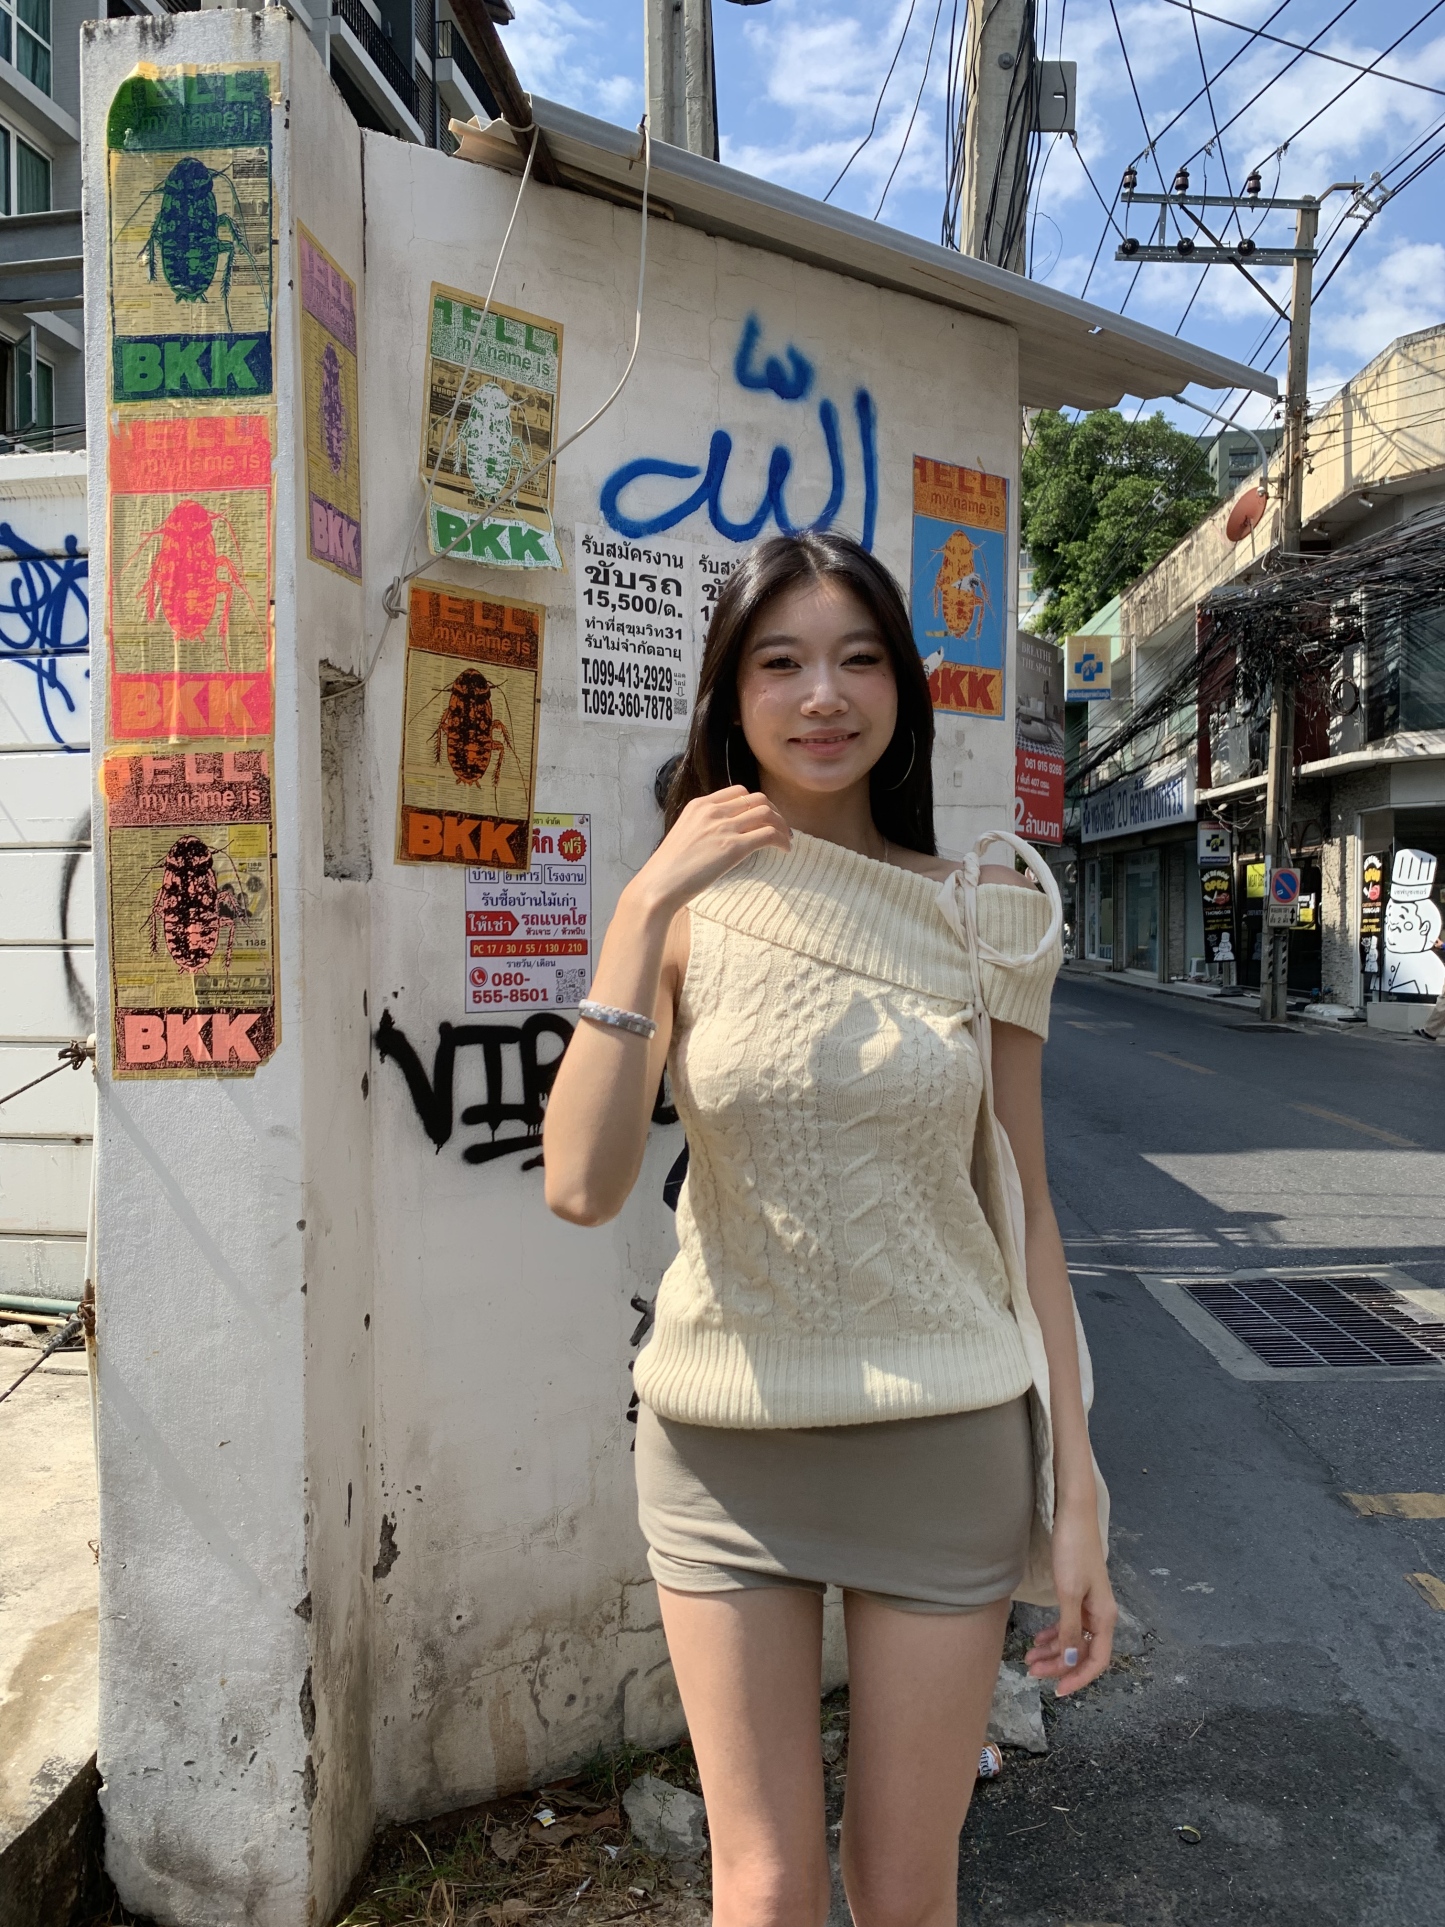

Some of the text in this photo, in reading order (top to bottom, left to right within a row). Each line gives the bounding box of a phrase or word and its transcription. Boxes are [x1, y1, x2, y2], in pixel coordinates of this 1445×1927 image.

[141, 106, 261, 134] my name is
[121, 339, 259, 393] BKK
[488, 346, 531, 369] name
[537, 358, 550, 375] is
[180, 454, 235, 472] name
[242, 453, 261, 472] is
[931, 492, 1000, 517] my name is
[313, 500, 357, 570] BKK
[436, 511, 550, 562] BKK
[582, 534, 683, 569] รับสมัครงาน
[584, 560, 682, 597] ขับรถ
[583, 588, 683, 618] 15,500/ด.
[435, 627, 530, 655] my name is
[585, 615, 682, 640] ทำที่สุขุมวิท31
[585, 633, 681, 662] รับไม่จำกัดอายุ
[1021, 641, 1052, 663] BREATHE
[582, 657, 672, 692] T.099-413-2929
[1021, 656, 1035, 670] THE
[119, 680, 256, 730] BKK
[582, 688, 672, 721] T.092-360-7878
[139, 786, 261, 813] my name is
[1117, 789, 1127, 828] 20
[1026, 811, 1060, 838] ล้านบาท
[409, 813, 519, 864] BKK
[562, 836, 581, 854] ฟรี
[547, 867, 584, 882] โรงงาน
[1204, 880, 1228, 891] OPEN
[482, 888, 576, 907] รับซื้อบ้านไม้เก่า
[468, 907, 587, 932] ให้เช่า รถแบคโฮ
[245, 938, 267, 947] 1188
[473, 945, 484, 954] PC
[487, 945, 496, 954] 17
[506, 944, 516, 953] 30
[525, 943, 536, 953] 55
[545, 943, 559, 953] 130
[568, 943, 582, 952] 210
[506, 958, 556, 969] รายวัน/เดือน
[491, 972, 530, 986] 080-
[473, 988, 548, 1004] 555-8501
[124, 1013, 262, 1063] BKK
